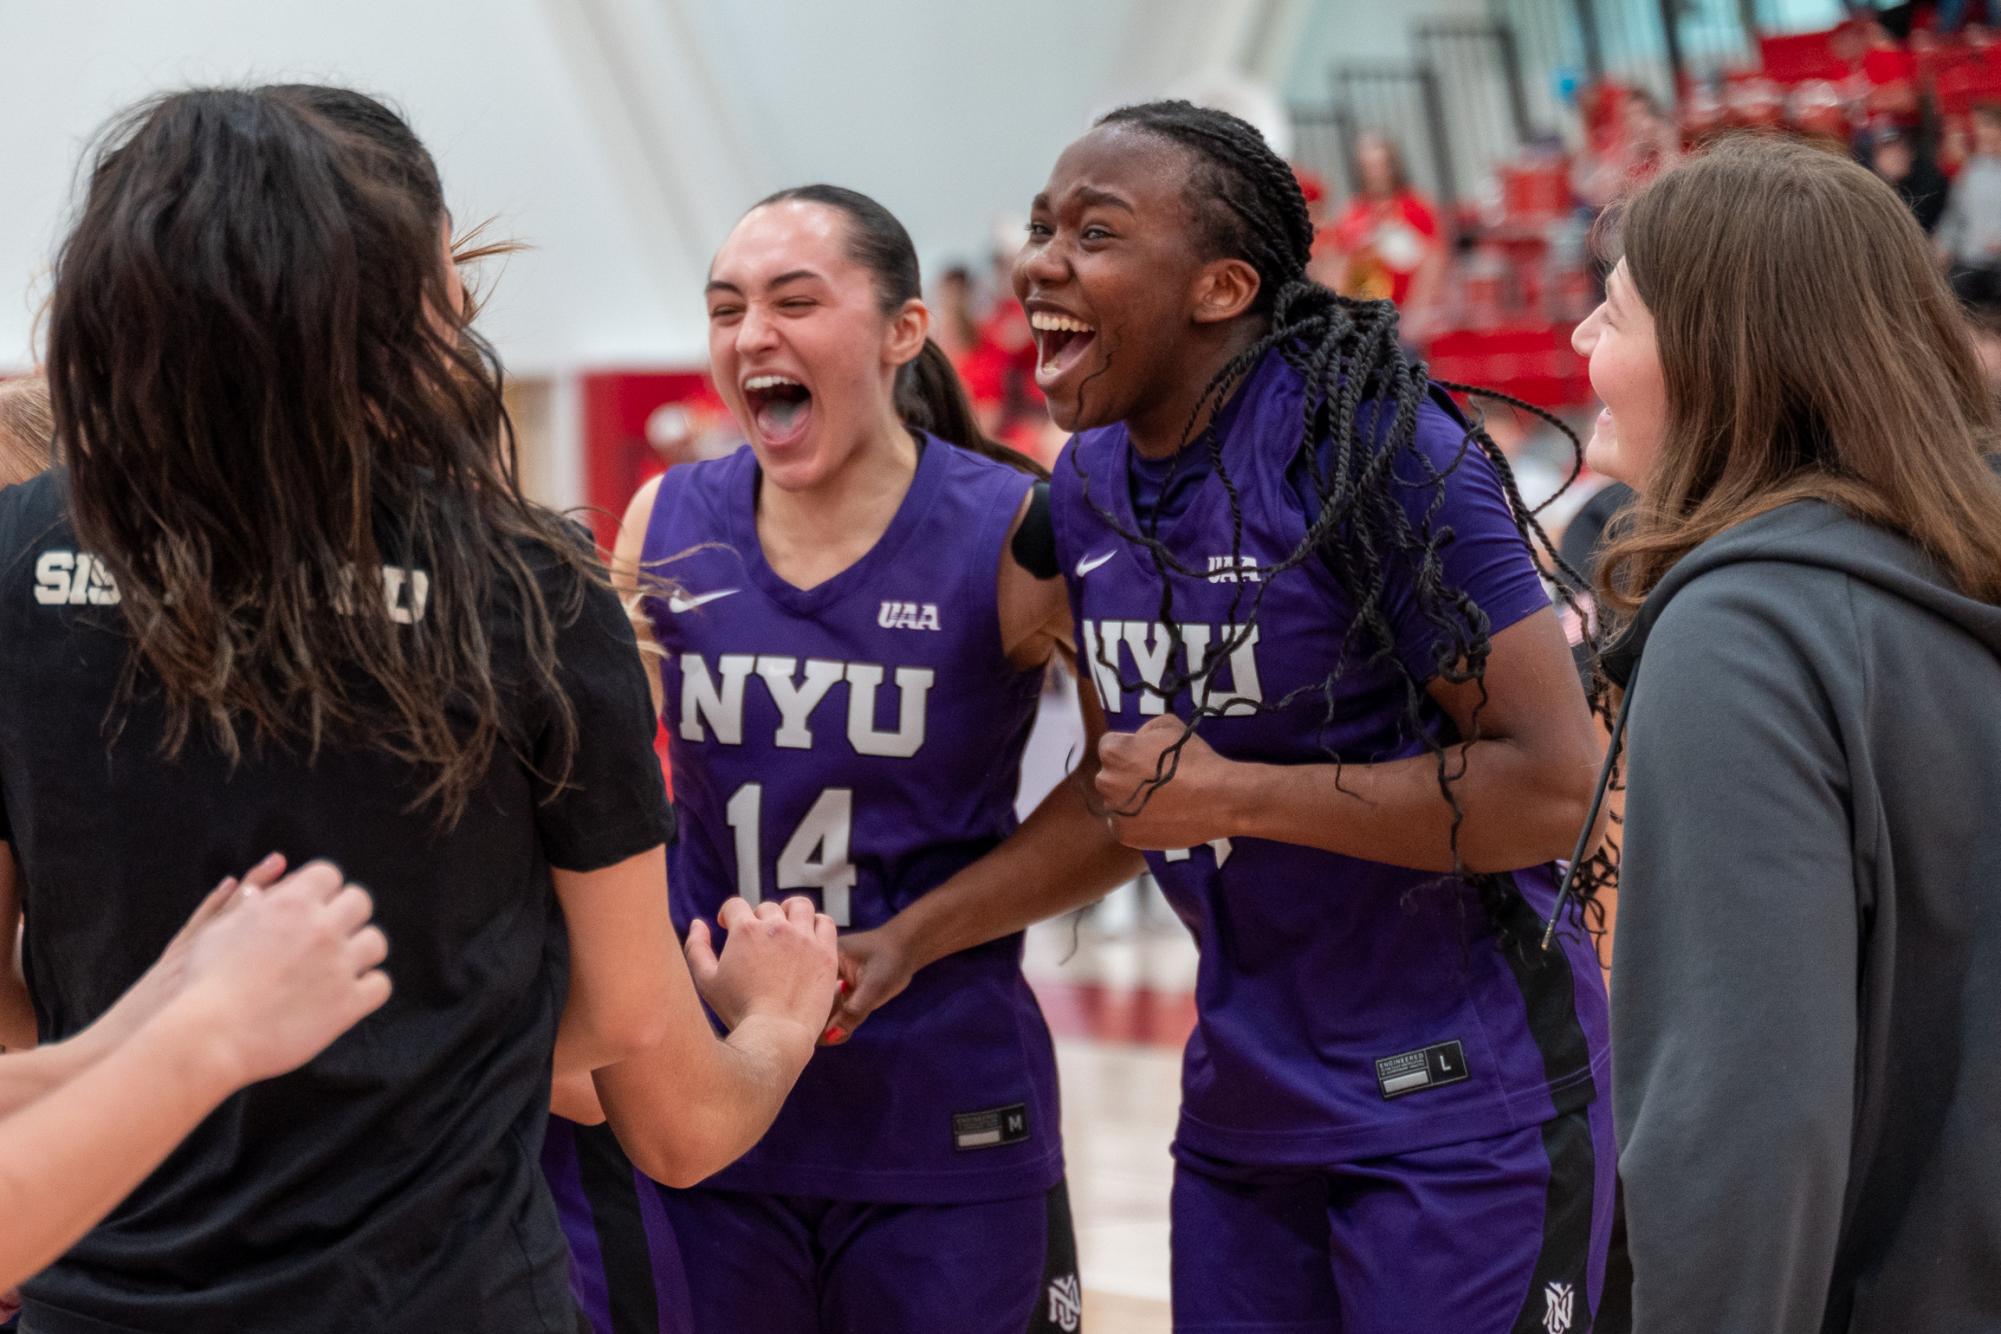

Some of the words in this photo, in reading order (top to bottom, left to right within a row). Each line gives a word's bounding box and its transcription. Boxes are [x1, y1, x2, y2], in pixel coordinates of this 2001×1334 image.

[877, 602, 941, 630] UAA
[1082, 620, 1263, 716] NYU
[680, 653, 934, 758] NYU
[727, 782, 856, 927] 14
[1440, 1055, 1452, 1071] L
[1008, 1114, 1023, 1132] M
